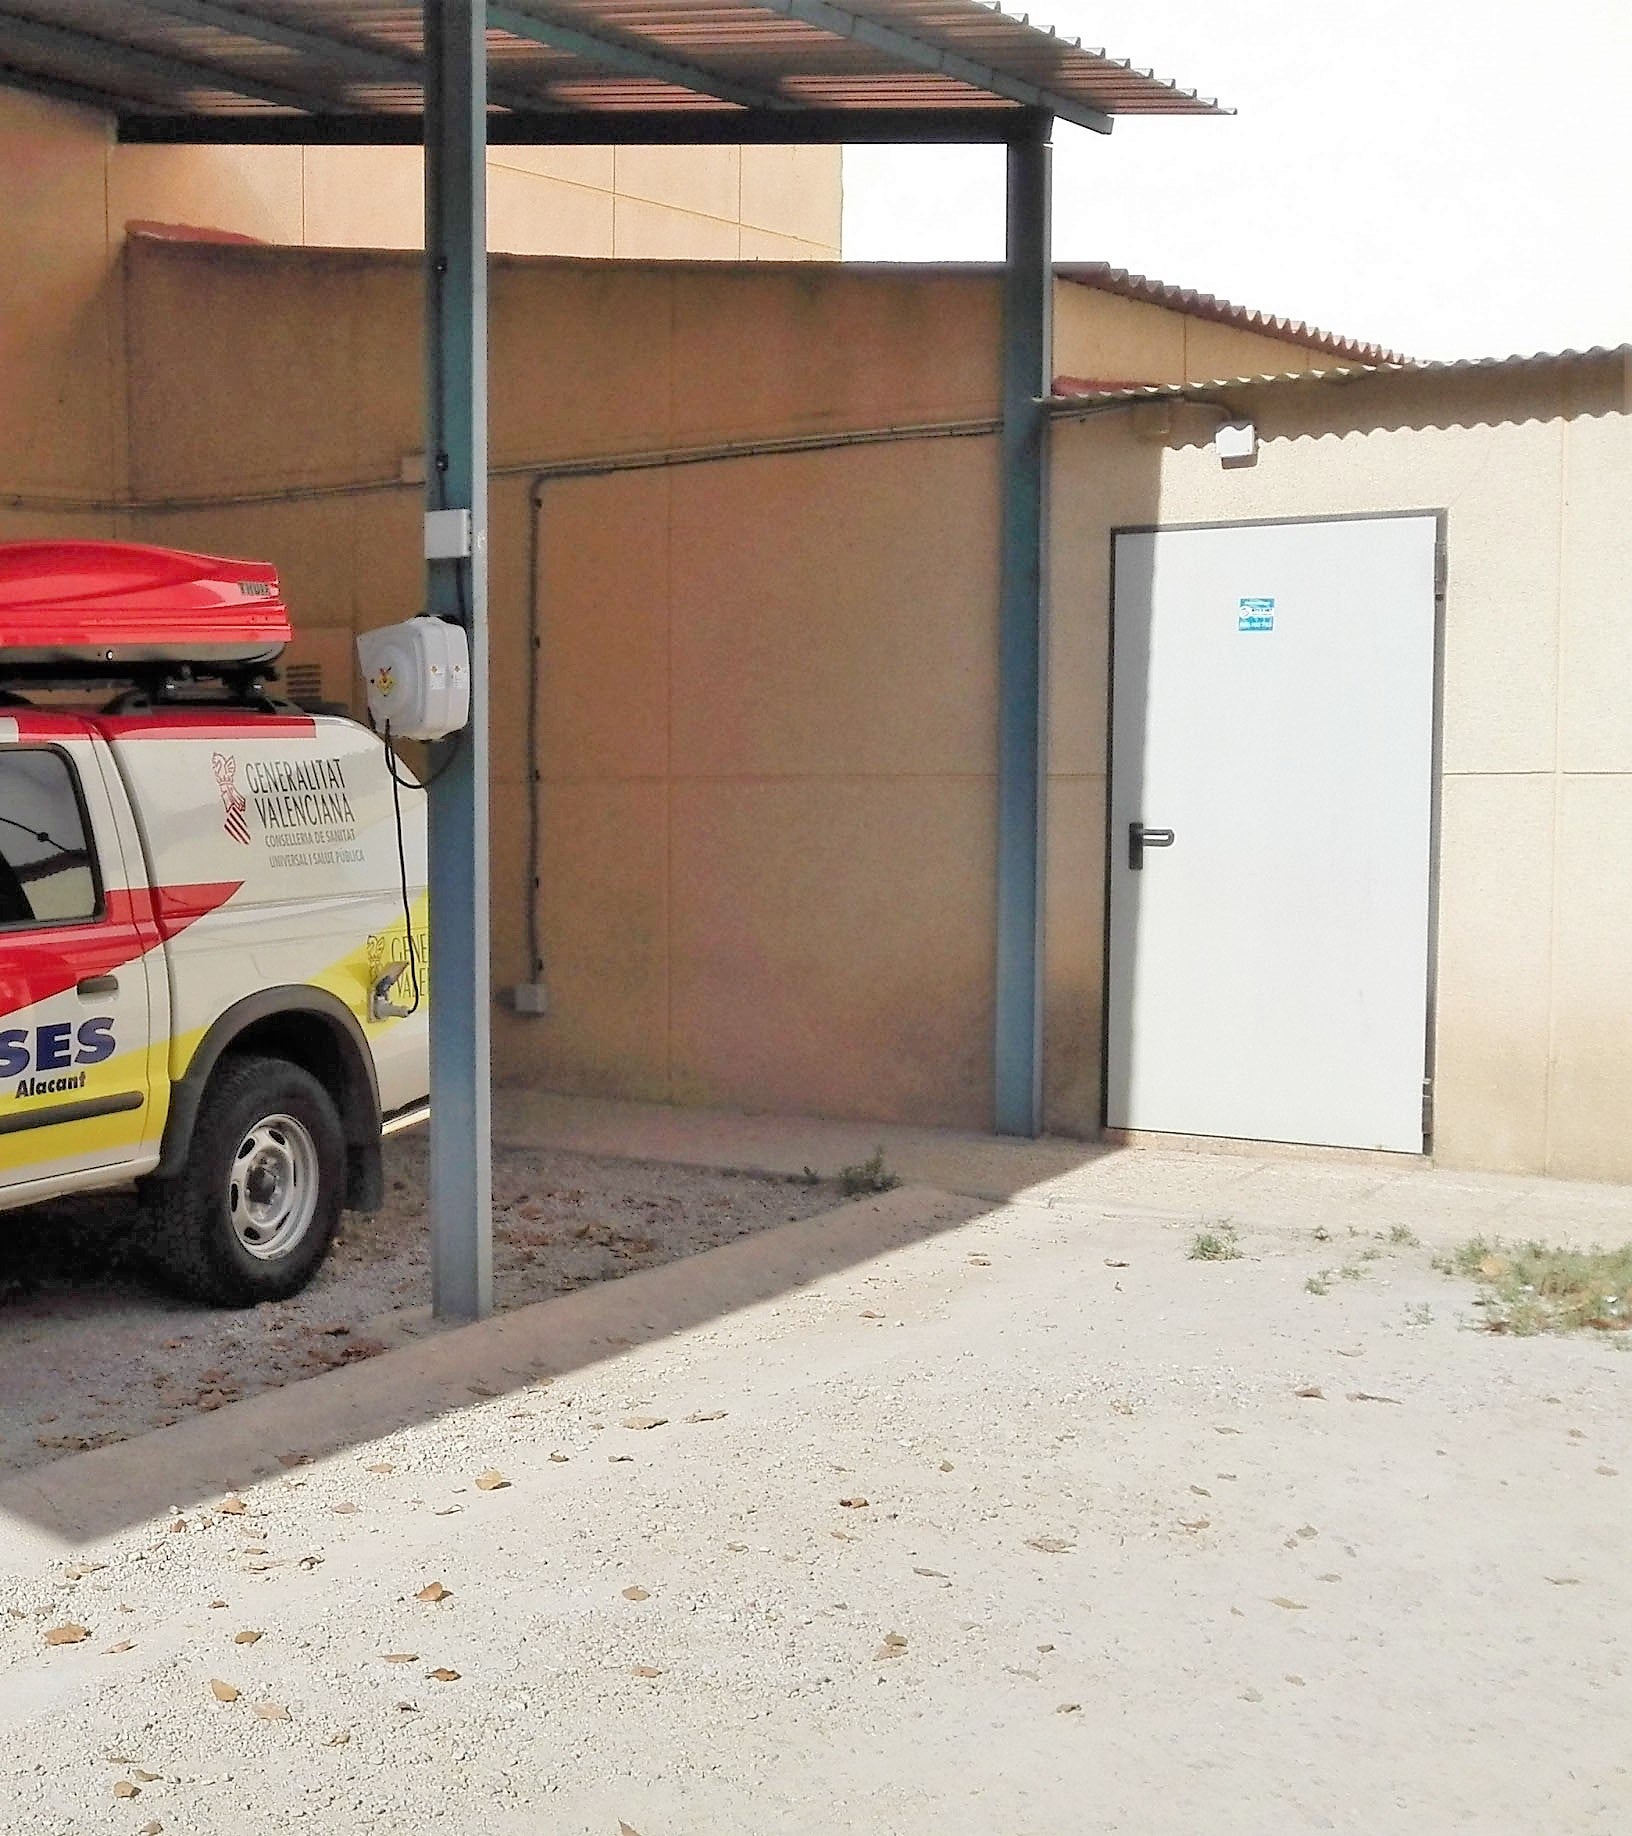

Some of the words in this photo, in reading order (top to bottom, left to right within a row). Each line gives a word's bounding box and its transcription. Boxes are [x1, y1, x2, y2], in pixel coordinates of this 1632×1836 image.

[246, 759, 346, 794] GENERALITAT
[254, 793, 356, 829] VALENCIANA
[264, 832, 313, 848] CONSELLERIA
[314, 831, 326, 844] DE
[326, 828, 356, 843] SANITAT
[269, 853, 308, 868] UNIVERSAL
[15, 1071, 86, 1099] Alacant
